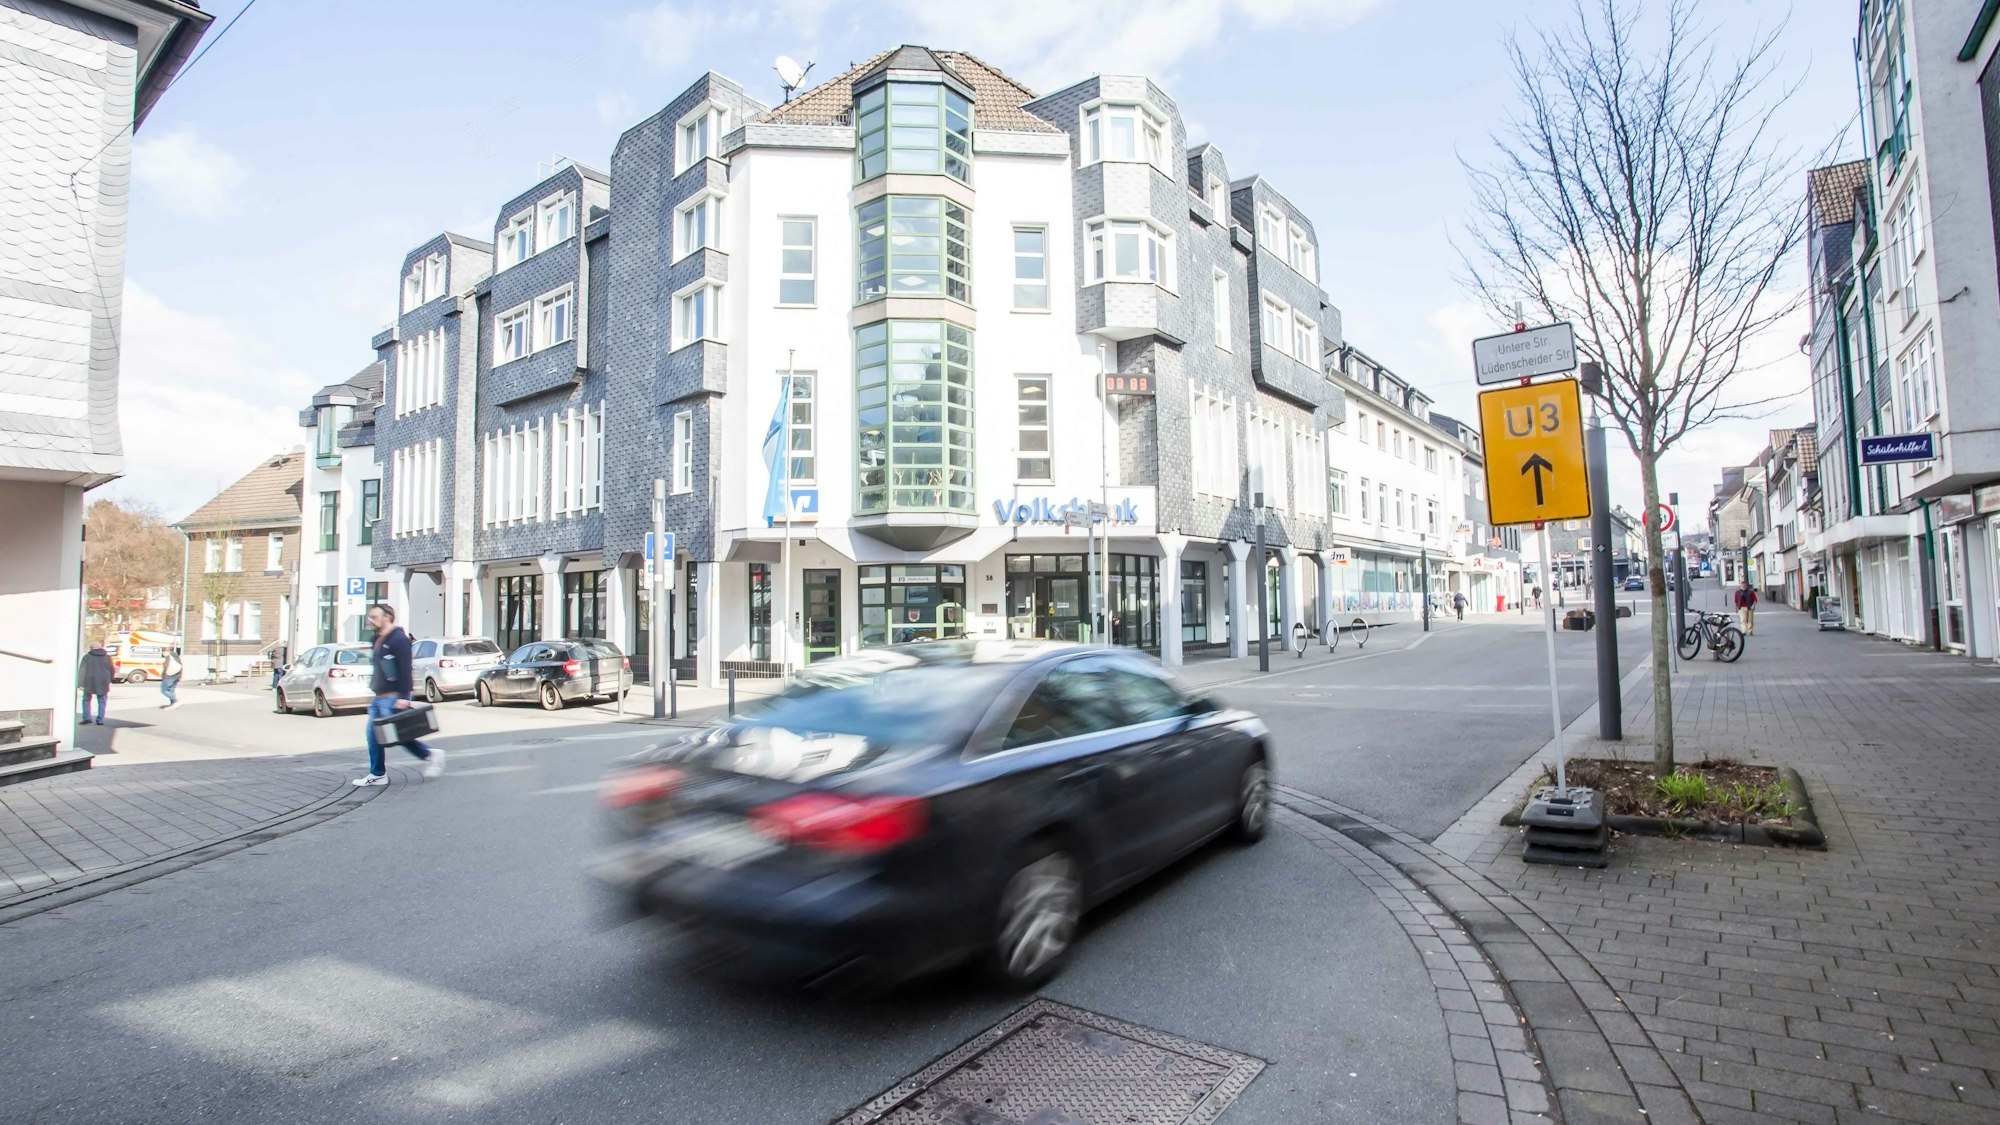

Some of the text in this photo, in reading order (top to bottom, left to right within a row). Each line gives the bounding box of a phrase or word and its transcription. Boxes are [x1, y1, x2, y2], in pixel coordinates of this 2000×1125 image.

[1497, 336, 1552, 355] Untere Str.
[1481, 354, 1552, 375] Lüdenscheider
